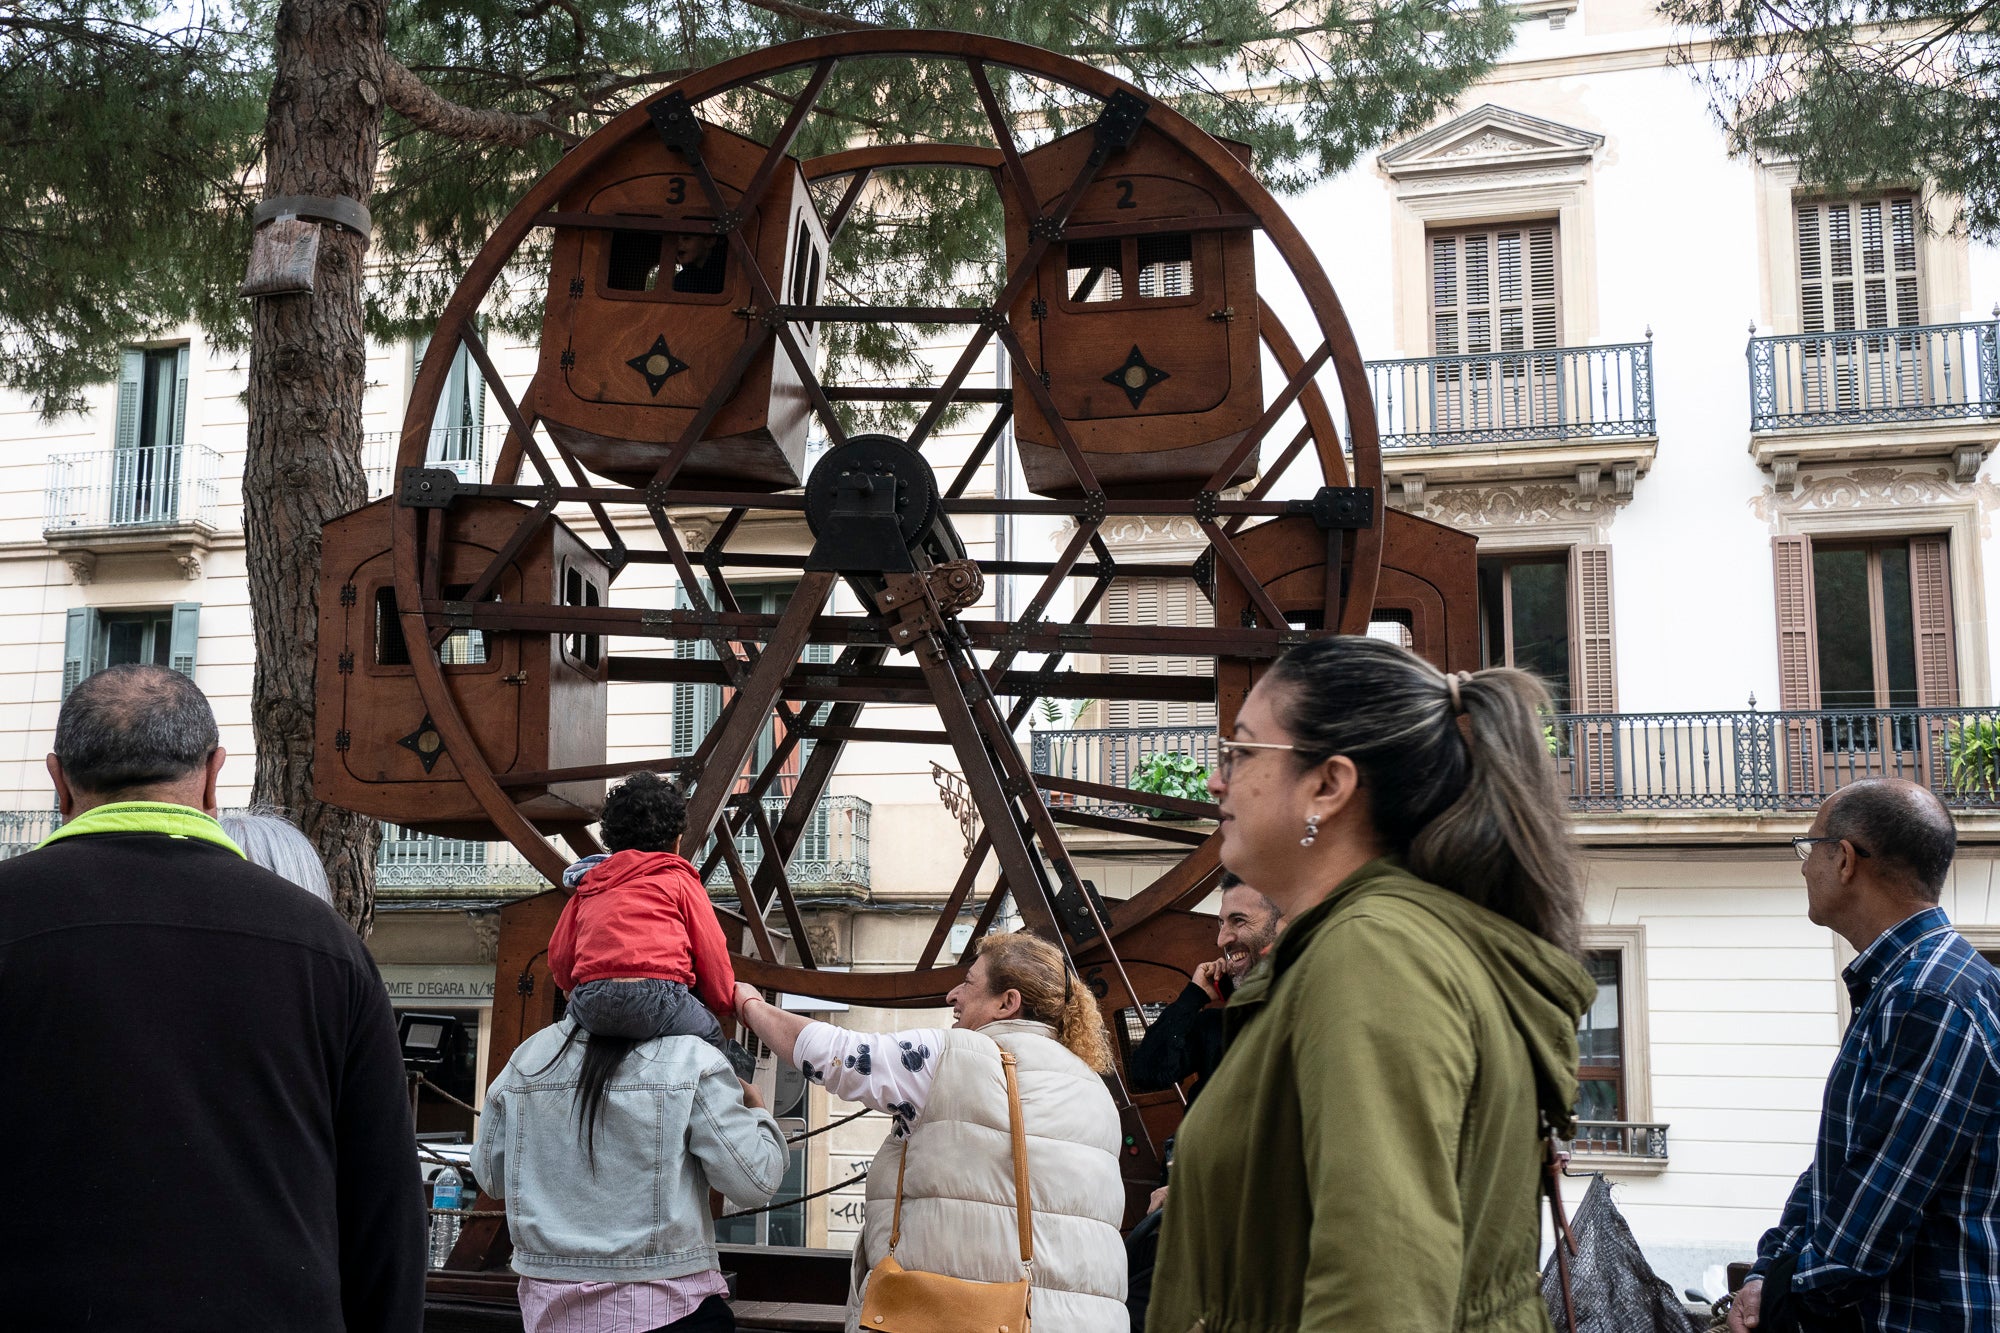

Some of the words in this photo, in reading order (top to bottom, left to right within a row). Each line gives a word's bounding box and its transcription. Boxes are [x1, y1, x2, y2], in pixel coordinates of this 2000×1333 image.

[665, 177, 686, 205] 3
[1116, 180, 1137, 210] 2
[417, 982, 465, 995] D'EGARA
[1086, 966, 1108, 999] 6
